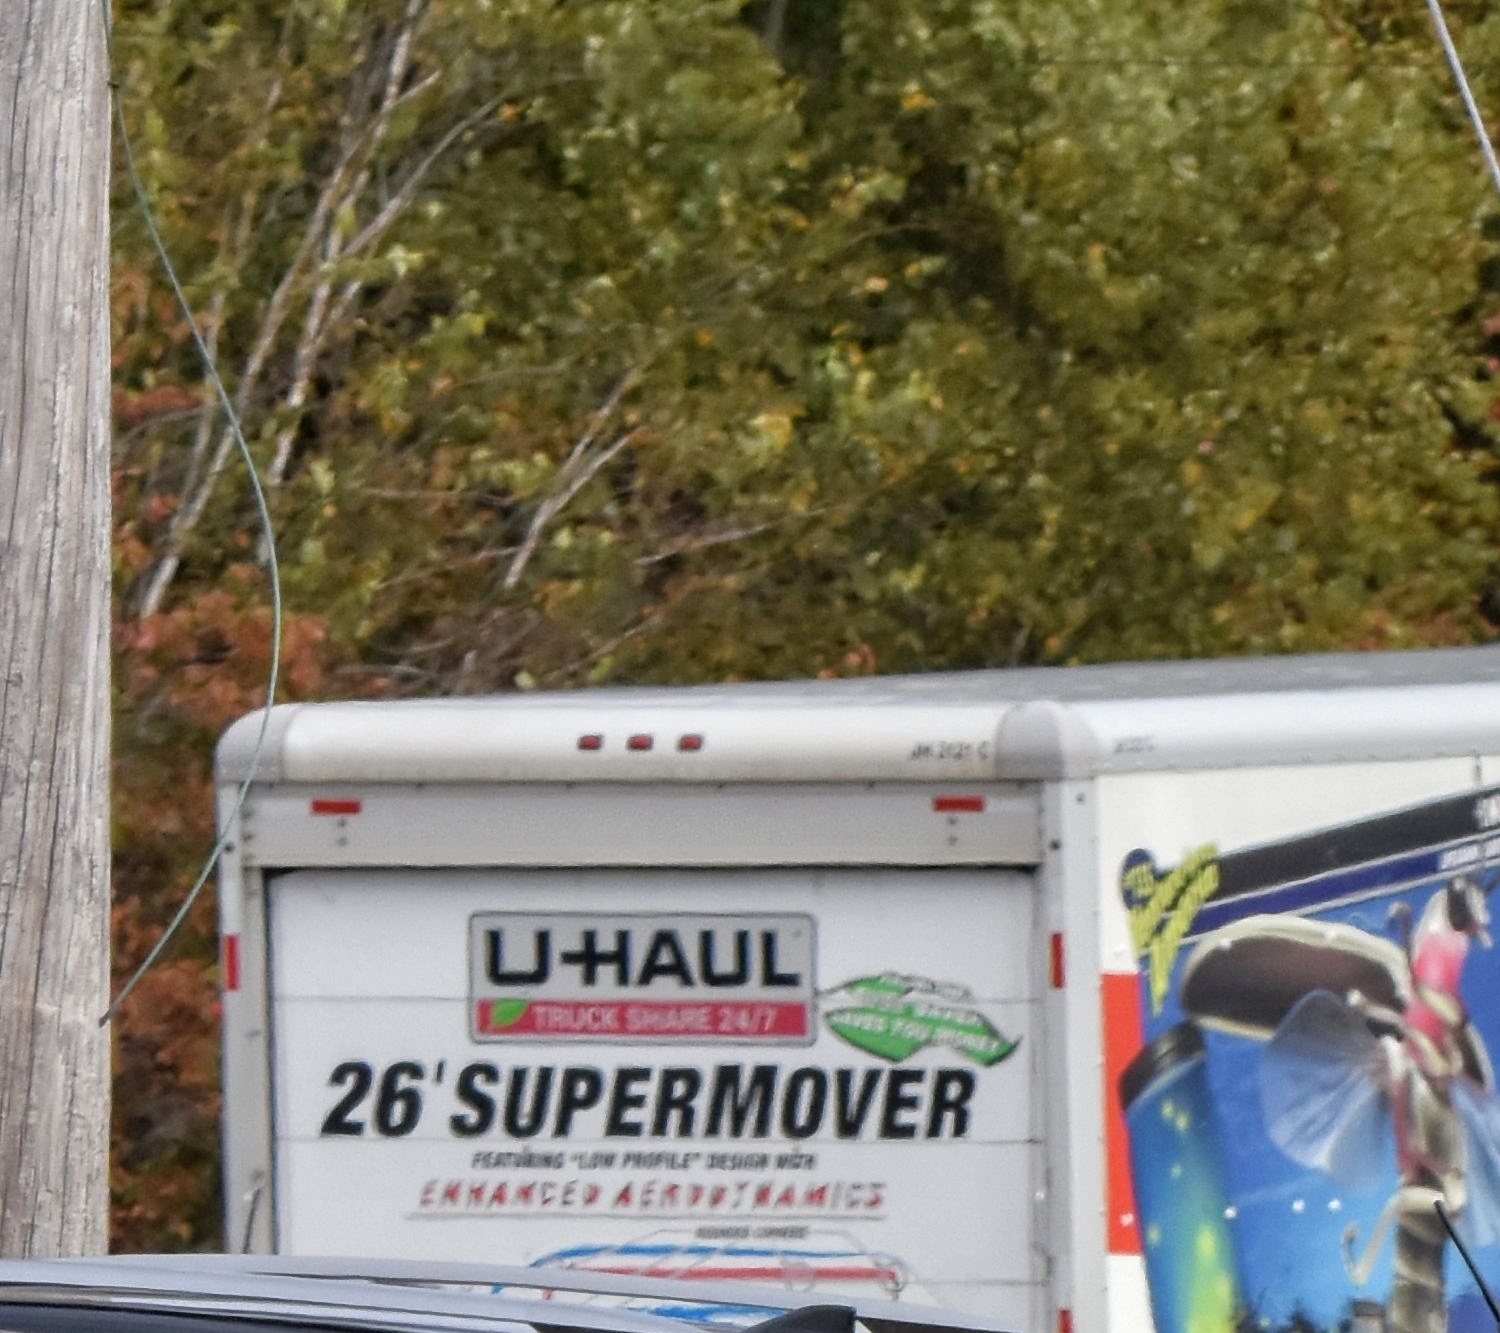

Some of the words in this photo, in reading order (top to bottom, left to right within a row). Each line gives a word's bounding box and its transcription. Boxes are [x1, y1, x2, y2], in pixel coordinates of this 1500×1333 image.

[484, 929, 803, 988] U-HAUL
[534, 1003, 619, 1032] TRUCK
[625, 1003, 711, 1032] SHARE
[718, 1002, 778, 1033] 24/7
[450, 1061, 977, 1139] SUPERMOVER
